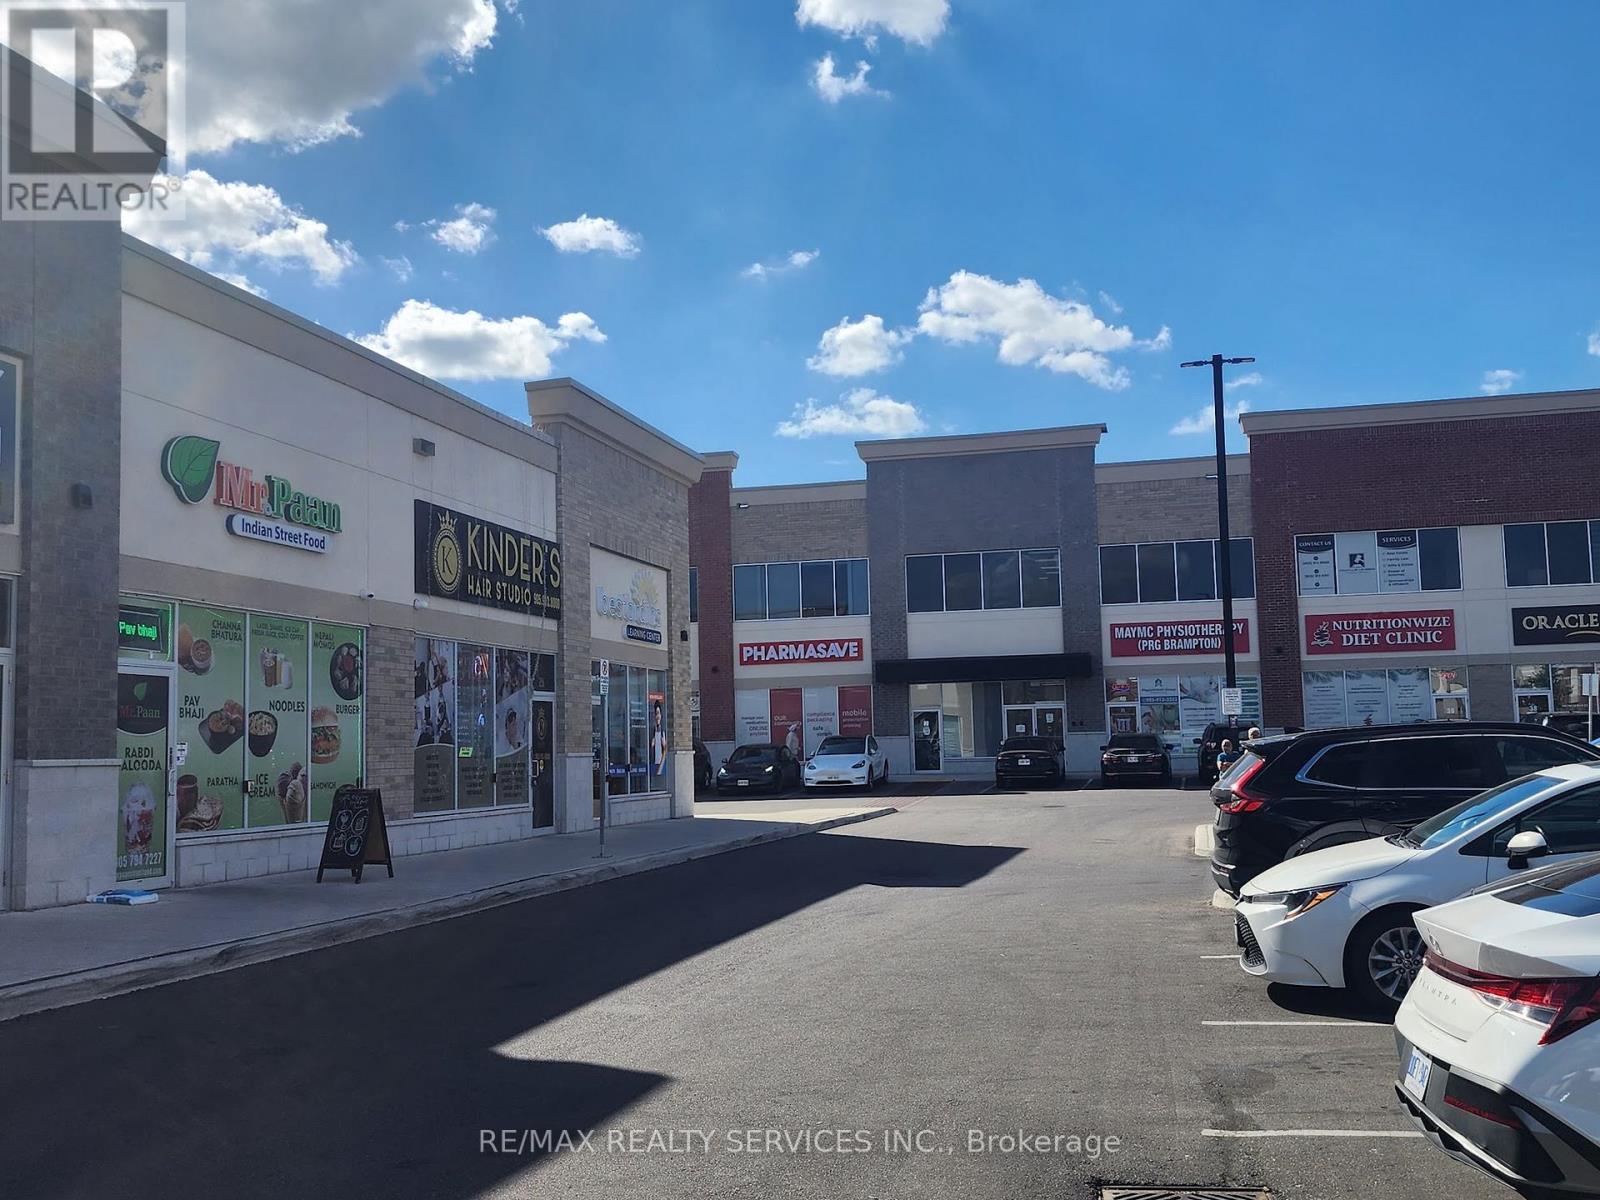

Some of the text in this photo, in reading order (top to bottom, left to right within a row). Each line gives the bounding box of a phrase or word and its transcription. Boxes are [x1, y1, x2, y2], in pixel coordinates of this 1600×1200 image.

[241, 518, 325, 549] Indian Street Food
[441, 546, 453, 575] K
[467, 521, 560, 588] KINDER'S
[467, 574, 492, 599] HAIR
[495, 581, 531, 606] STUDIO
[212, 619, 242, 631] CHANNA
[1333, 616, 1451, 631] NUTRITIONWIZE
[1522, 613, 1600, 630] ORACLE
[211, 630, 243, 642] BHATURA
[1115, 622, 1244, 639] MAYMC PHYSIOTHERPY
[1138, 637, 1222, 651] (PRG BRAMPTON)
[1341, 630, 1443, 646] DIET CLINIC
[742, 641, 858, 662] PHARMASAVE
[184, 695, 200, 707] PAV
[269, 700, 306, 713] NOODLES
[179, 707, 204, 719] BHAJI
[335, 704, 360, 715] BURGER
[842, 708, 867, 717] mobile
[125, 747, 154, 759] RABDI
[206, 776, 239, 787] PARATHA
[256, 773, 269, 785] ICE
